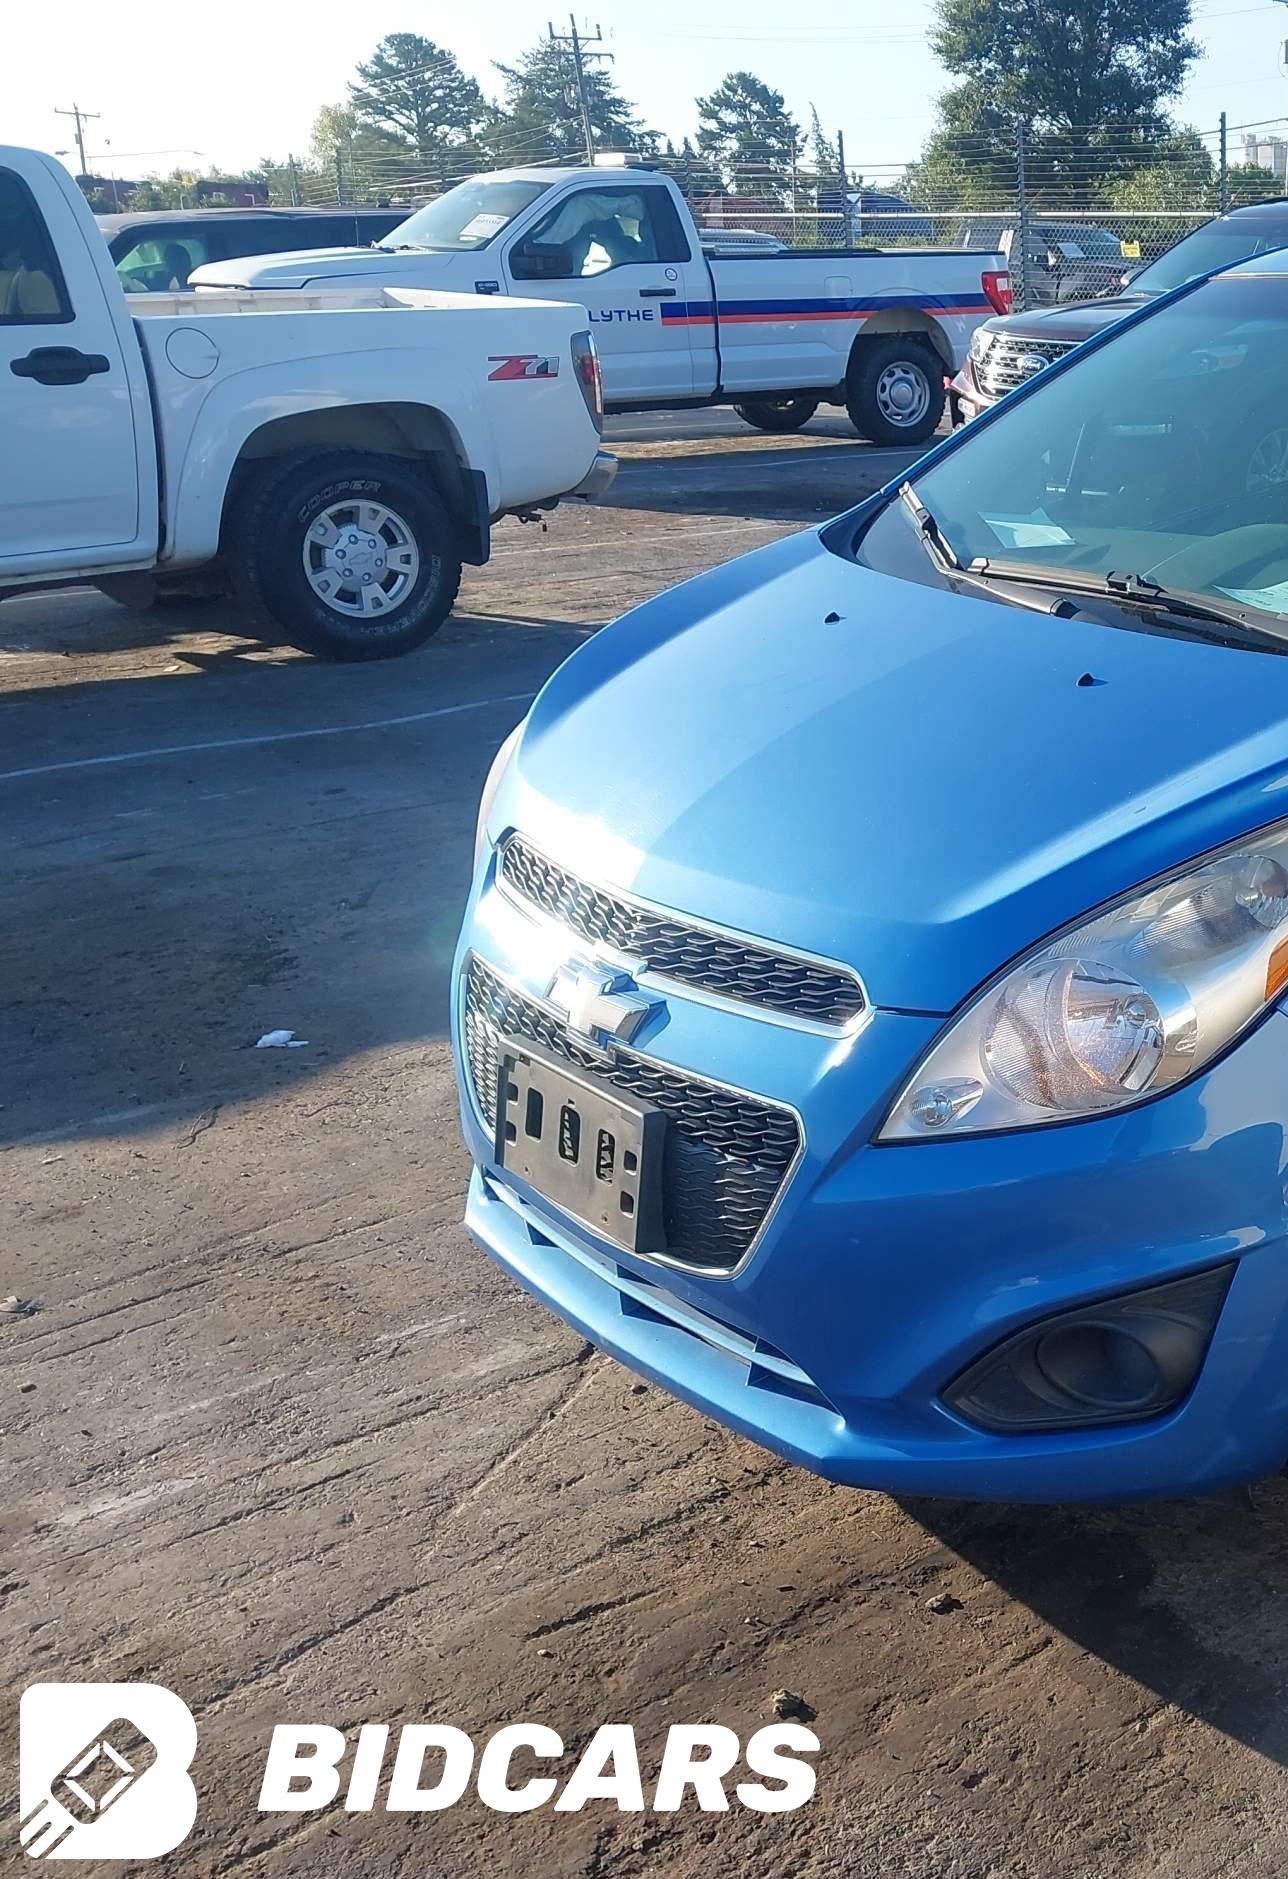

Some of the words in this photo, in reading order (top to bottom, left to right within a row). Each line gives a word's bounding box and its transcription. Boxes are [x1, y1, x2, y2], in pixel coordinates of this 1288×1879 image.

[588, 309, 654, 322] LYTHE
[488, 354, 560, 381] Z71
[298, 479, 382, 522] COOPER
